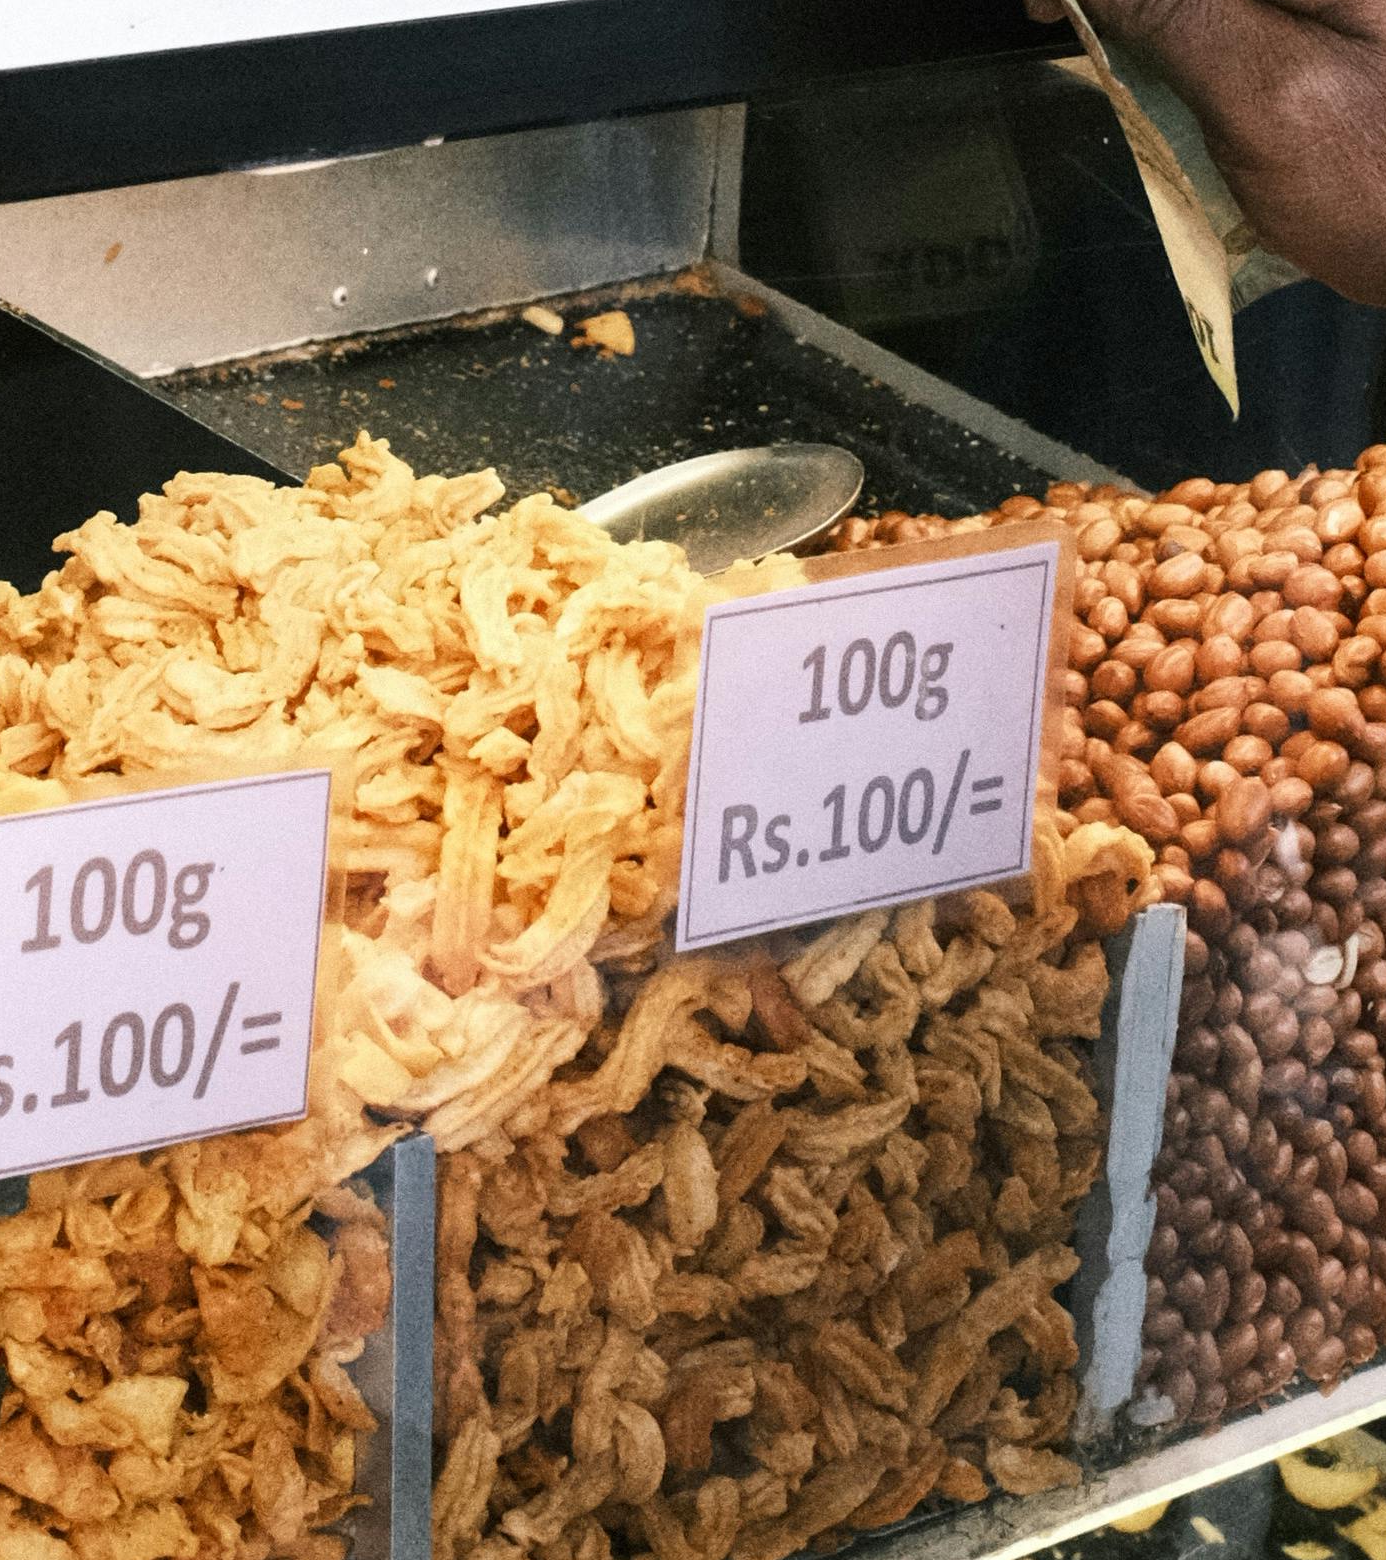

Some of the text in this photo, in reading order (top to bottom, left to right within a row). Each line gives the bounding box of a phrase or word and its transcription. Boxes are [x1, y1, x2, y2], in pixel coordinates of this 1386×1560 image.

[798, 629, 955, 724] 100g
[718, 748, 1005, 884] Rs.100/=
[21, 848, 216, 953] 100g
